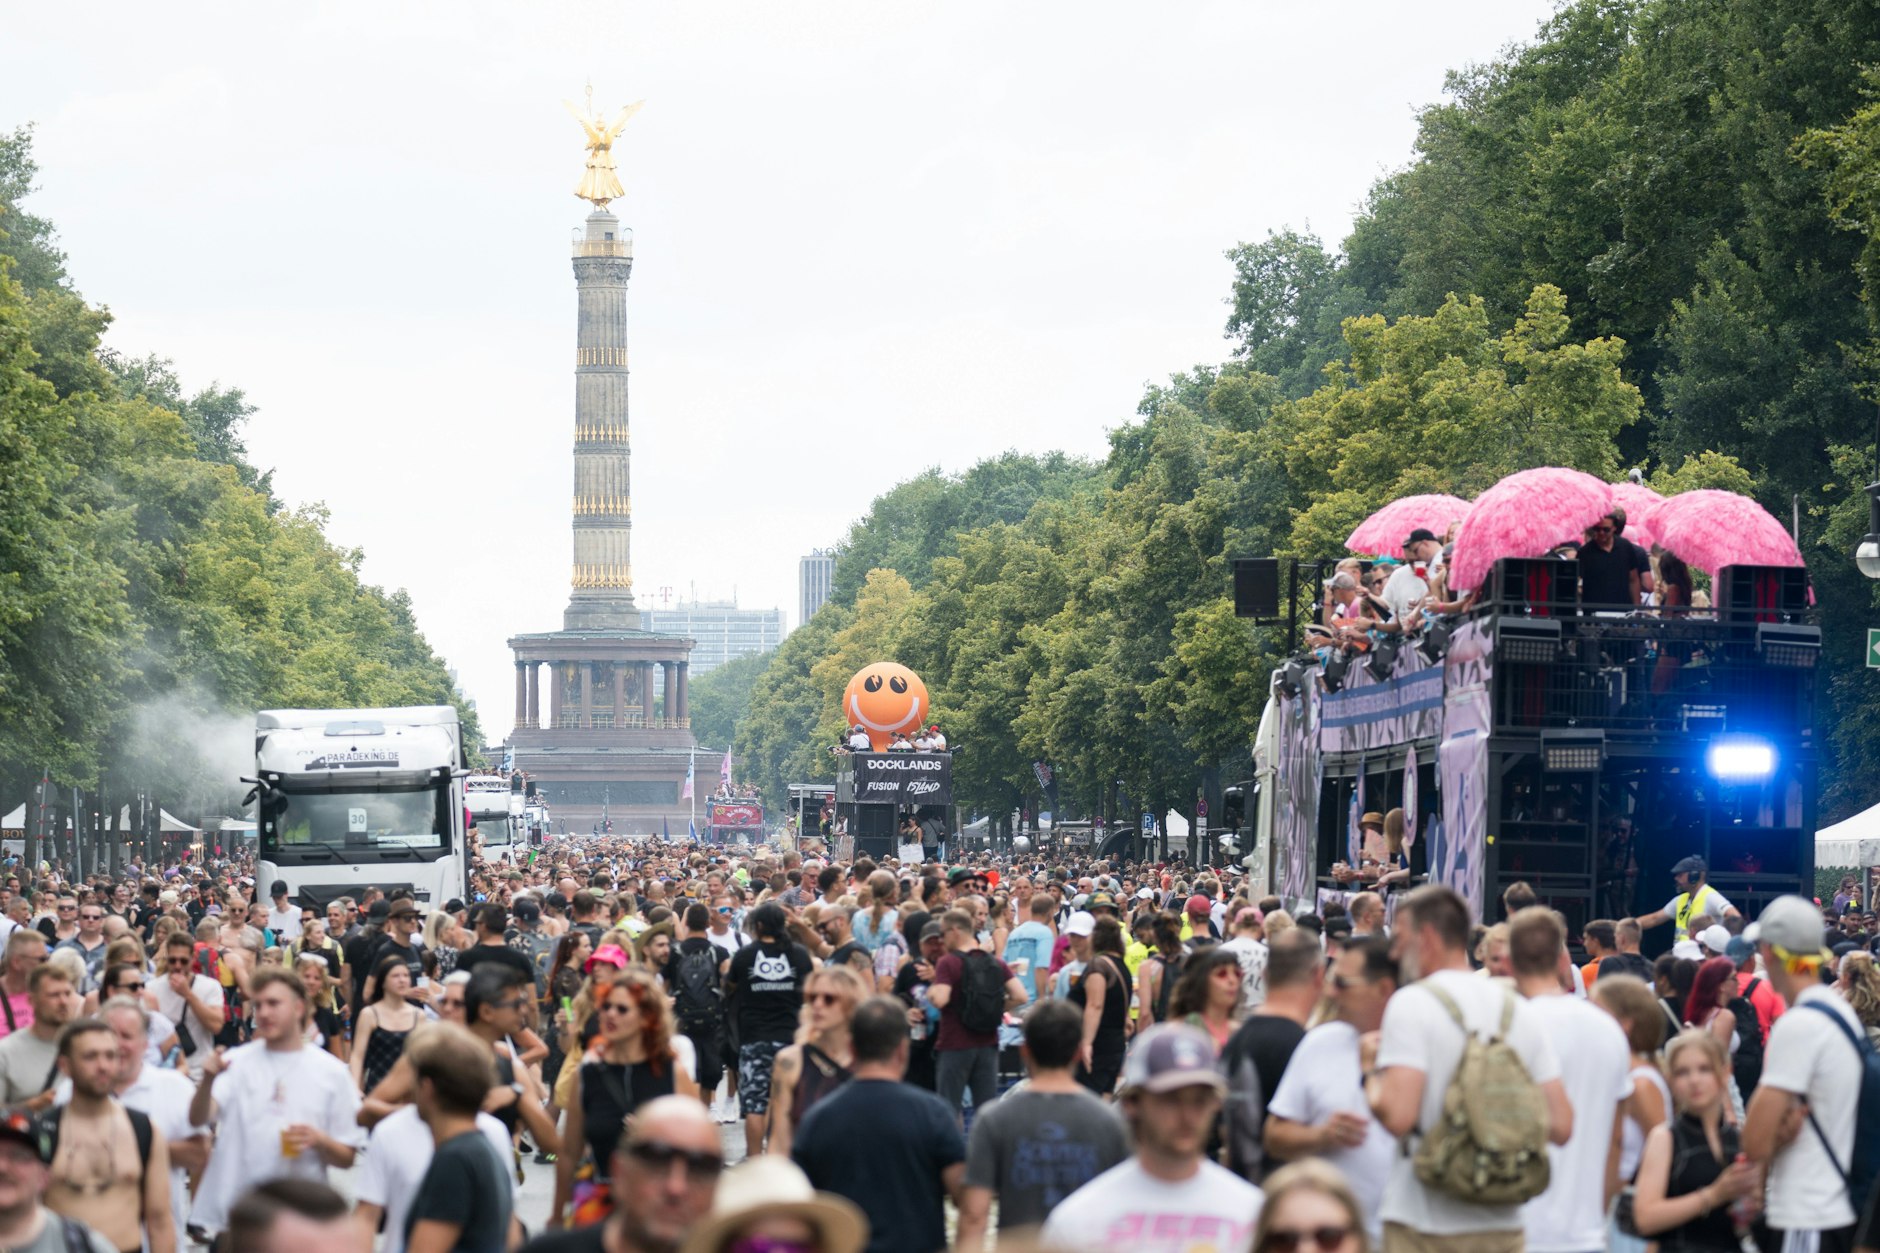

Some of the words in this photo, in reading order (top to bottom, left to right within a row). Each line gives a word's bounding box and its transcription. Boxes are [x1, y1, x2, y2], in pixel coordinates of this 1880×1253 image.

[867, 760, 942, 771] DOCKLANDS
[867, 782, 899, 790] FUSION
[906, 781, 940, 795] ISLAND
[351, 814, 365, 824] 30
[1144, 815, 1151, 827] P
